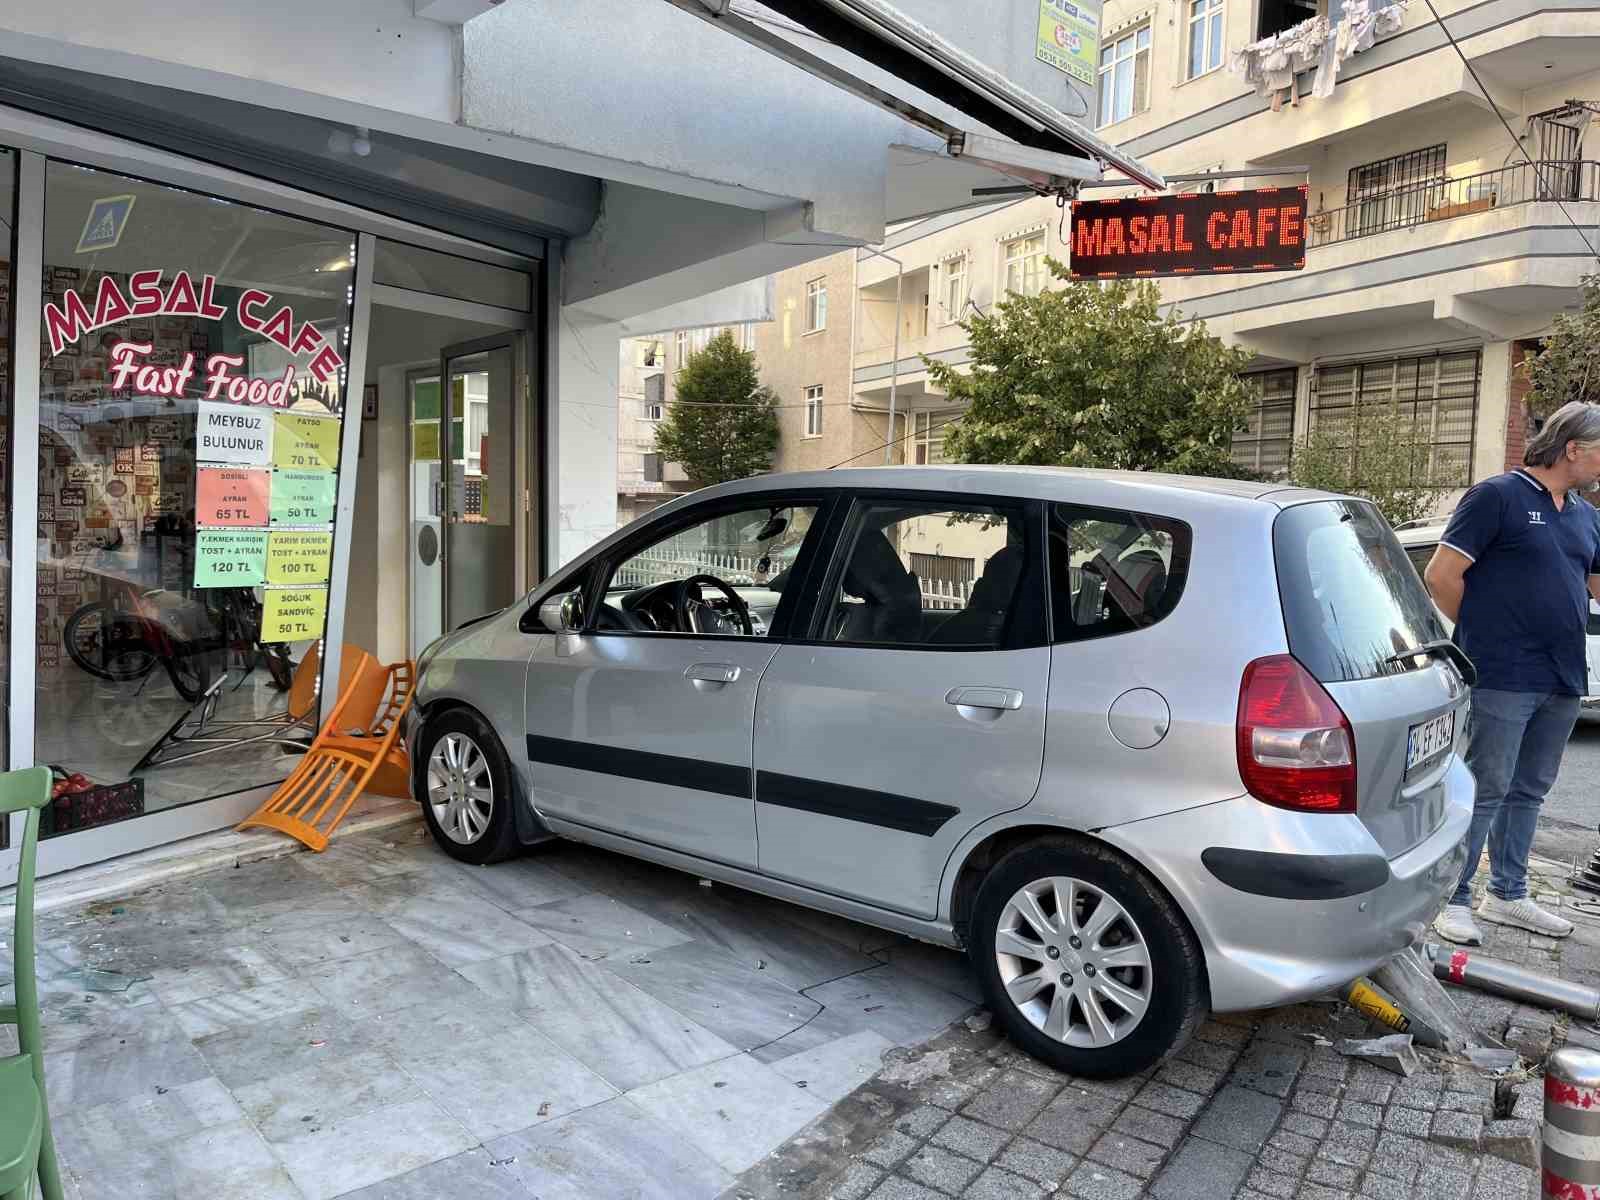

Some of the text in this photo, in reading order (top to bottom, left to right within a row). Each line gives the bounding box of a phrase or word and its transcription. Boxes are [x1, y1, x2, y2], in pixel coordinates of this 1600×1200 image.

[1077, 206, 1300, 256] MASAL CAFE
[45, 269, 345, 384] MASAL CAFE
[110, 342, 297, 407] Fast Food
[208, 414, 262, 430] MEYBUZ
[203, 435, 264, 451] BULUNUR
[291, 455, 321, 466] 70 TL
[216, 509, 250, 520] 65 TL
[287, 508, 318, 518] 50 TL
[201, 547, 225, 555] TOST
[234, 547, 262, 555] AYRAN
[271, 549, 293, 557] TOST
[211, 562, 252, 572] 120 TL
[281, 563, 318, 573] 100 TL
[281, 593, 312, 603] SOĞUK
[277, 607, 316, 617] SANDVİÇ
[279, 623, 309, 633] 50 TL
